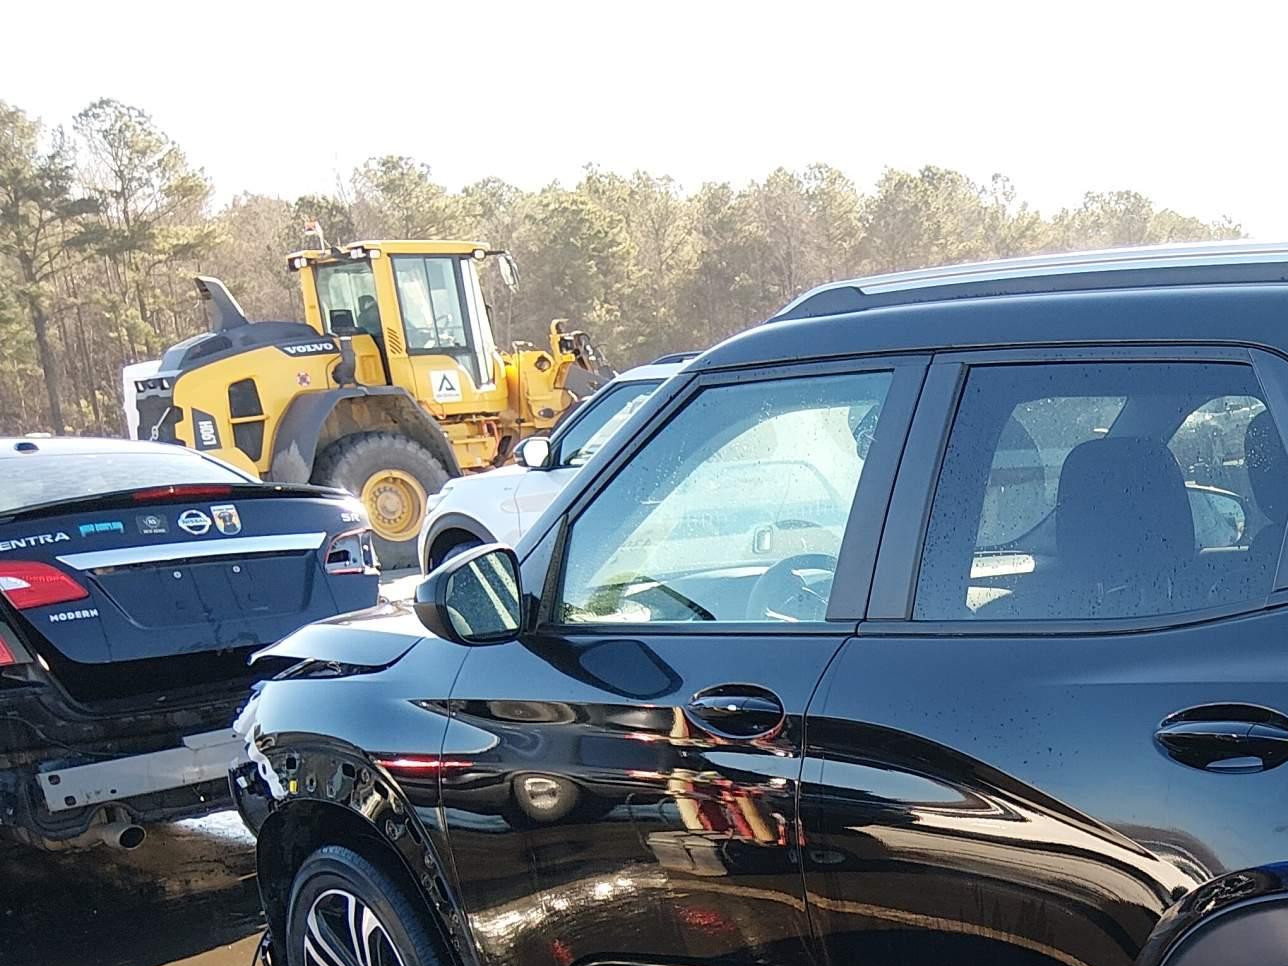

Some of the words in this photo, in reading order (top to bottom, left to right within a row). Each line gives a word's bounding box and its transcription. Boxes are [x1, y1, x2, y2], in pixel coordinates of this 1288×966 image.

[284, 343, 334, 354] VOLVO
[340, 512, 361, 522] SR
[49, 609, 99, 622] MODERN
